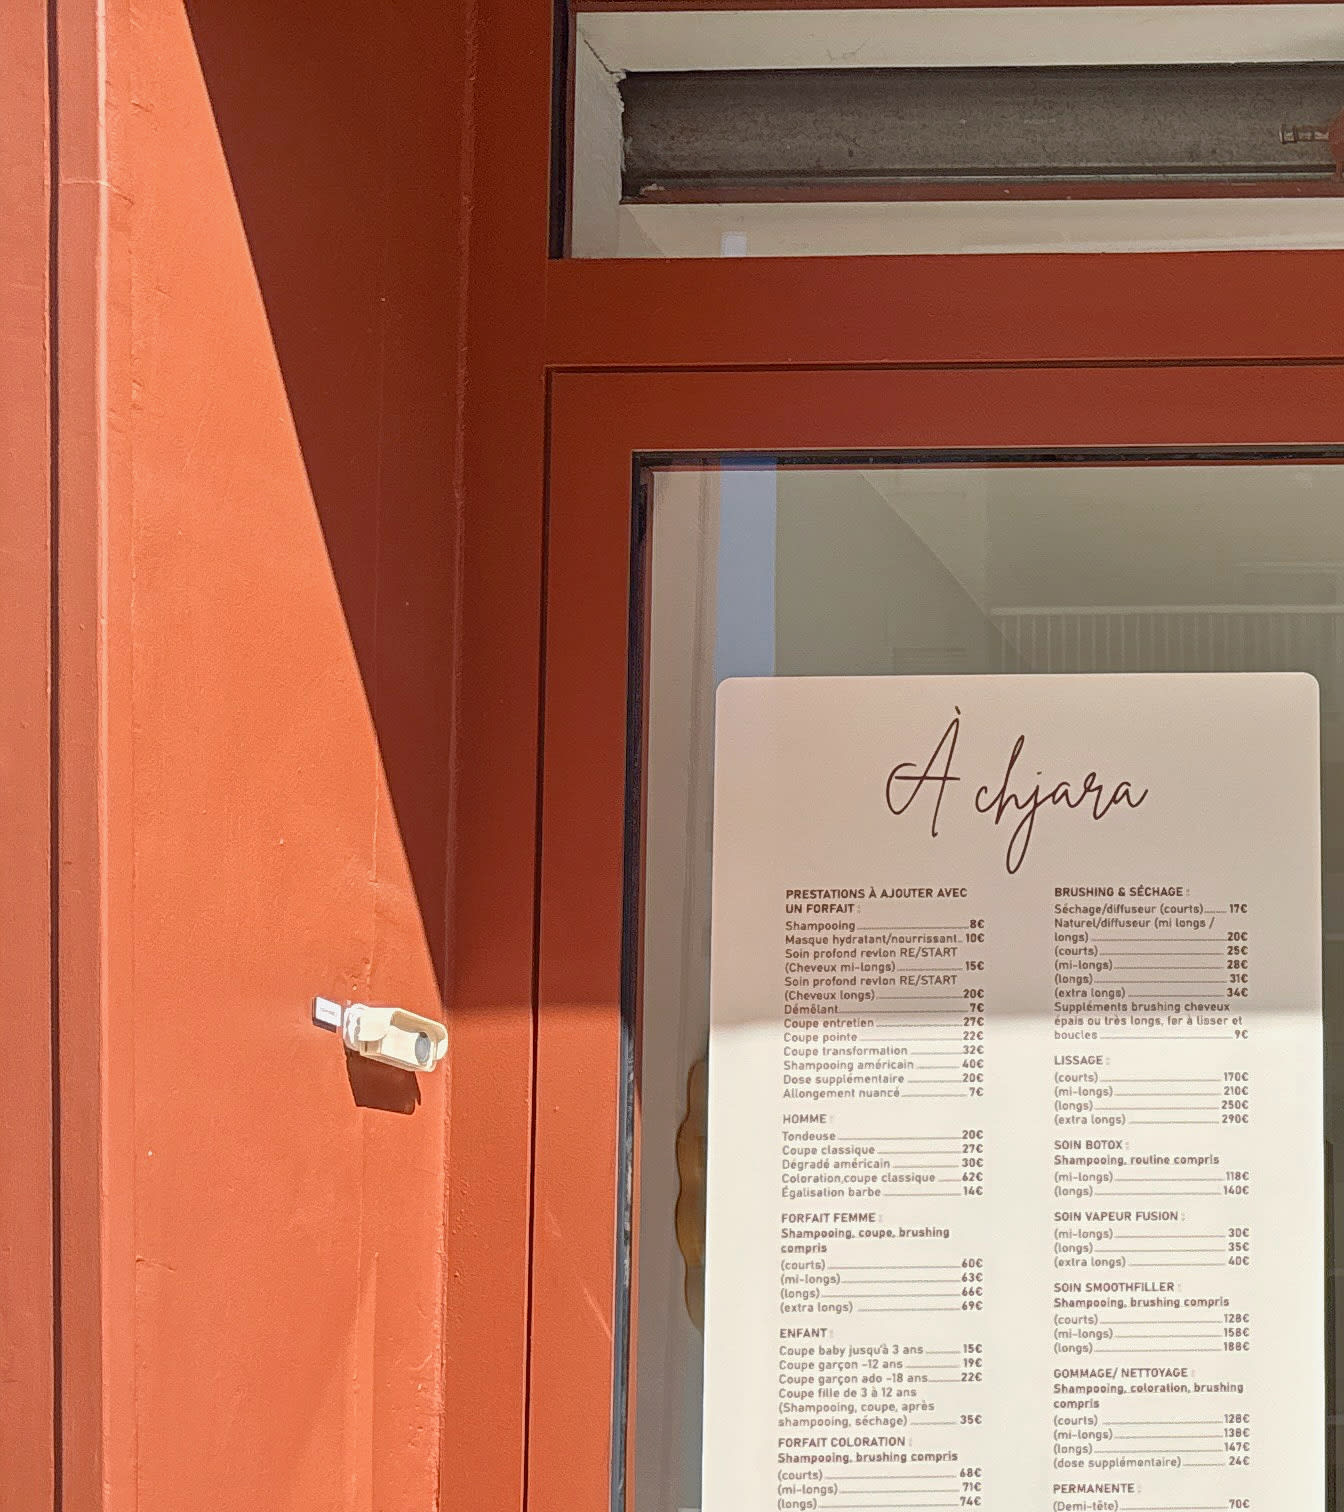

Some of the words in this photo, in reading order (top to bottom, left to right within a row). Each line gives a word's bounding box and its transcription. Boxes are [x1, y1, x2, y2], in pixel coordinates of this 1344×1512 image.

[886, 705, 961, 838] À
[975, 735, 1149, 874] chjara
[786, 889, 865, 898] PRESTATIONS
[869, 887, 877, 898] À
[881, 889, 933, 898] AJOUTER
[937, 888, 967, 897] AVEC
[1055, 887, 1114, 897] BRUSHING
[1118, 887, 1126, 896] &
[1129, 885, 1183, 896] SÉCHAGE
[786, 904, 802, 913] UN
[807, 904, 854, 913] FORFAIT
[1055, 904, 1156, 915] Séchage/diffuseur
[1160, 903, 1203, 915] (courts)
[1230, 904, 1247, 913] 17€
[785, 921, 855, 932] Shampooing
[970, 920, 984, 928] 8€
[1055, 917, 1150, 928] Naturel/diffuseur
[1176, 918, 1206, 929] longs
[786, 936, 828, 946] Masque
[833, 934, 957, 945] hydratant/nourrissant
[966, 934, 984, 942] 10€
[1055, 932, 1089, 943] longs)
[1227, 932, 1248, 941] 20€
[785, 949, 809, 958] Soin
[814, 949, 856, 960] profond
[861, 948, 896, 957] revlon
[900, 947, 957, 958] RE/START
[1055, 946, 1098, 957] (courts)
[1227, 946, 1248, 955] 25€
[785, 963, 836, 973] (Cheveux
[841, 961, 895, 973] mi-longs)
[966, 961, 984, 970] 15€
[1055, 960, 1113, 972] (mi-longs)
[1227, 960, 1248, 969] 28€
[1055, 974, 1093, 985] (longs)
[1230, 974, 1248, 983] 31€
[785, 991, 836, 1001] (Cheveux
[840, 990, 875, 1001] longs)
[963, 989, 984, 999] 20€
[1055, 988, 1087, 999] (extra
[1091, 988, 1125, 999] longs)
[1227, 988, 1248, 997] 34€
[785, 1005, 838, 1014] Démêlant
[970, 1003, 984, 1012] 7€
[1054, 1002, 1127, 1014] Suppléments
[1132, 1002, 1180, 1013] brushing
[1185, 1002, 1230, 1011] cheveux
[784, 1019, 819, 1029] Coupe
[823, 1018, 874, 1028] entretien
[963, 1017, 984, 1026] 27€
[1055, 1030, 1097, 1040] boucles
[1235, 1031, 1248, 1039] 9€
[784, 1047, 818, 1057] Coupe
[823, 1046, 907, 1056] transformation
[963, 1046, 984, 1054] 32€
[784, 1060, 853, 1071] Shampooing
[858, 1059, 914, 1069] américain
[962, 1059, 984, 1068] 40€
[1055, 1056, 1103, 1065] LISSAGE
[1055, 1072, 1098, 1083] (courts)
[1224, 1072, 1248, 1082] 170€
[783, 1114, 827, 1124] HOMME
[782, 1132, 836, 1141] Tondeuse
[962, 1130, 983, 1139] 20€
[782, 1146, 817, 1156] Coupe
[822, 1145, 875, 1156] classique
[962, 1144, 983, 1153] 27€
[1054, 1140, 1081, 1150] SOIN
[1086, 1140, 1122, 1149] BOTOX
[782, 1186, 844, 1199] Égalisation
[849, 1188, 881, 1197] barbe
[964, 1186, 983, 1195] 14€
[782, 1213, 830, 1223] FORFAIT
[834, 1213, 876, 1222] FEMME
[1054, 1212, 1081, 1221] SOIN
[1086, 1212, 1132, 1221] VAPEUR
[1136, 1211, 1178, 1221] FUSION
[900, 1227, 949, 1238] brushing
[781, 1244, 827, 1253] compris
[781, 1259, 825, 1269] (courts)
[962, 1259, 983, 1268] 60€
[1054, 1283, 1081, 1292] SOIN
[1086, 1282, 1174, 1292] SMOOTHFILLER
[780, 1329, 827, 1338] ENFANT
[780, 1346, 815, 1356] Coupe
[819, 1346, 846, 1356] baby
[963, 1344, 982, 1353] 15€
[1122, 1368, 1188, 1377] NETTOYAGE
[778, 1438, 826, 1447] FORFAIT
[831, 1437, 905, 1447] COLORATION
[1053, 1483, 1134, 1494] PERMANENTE
